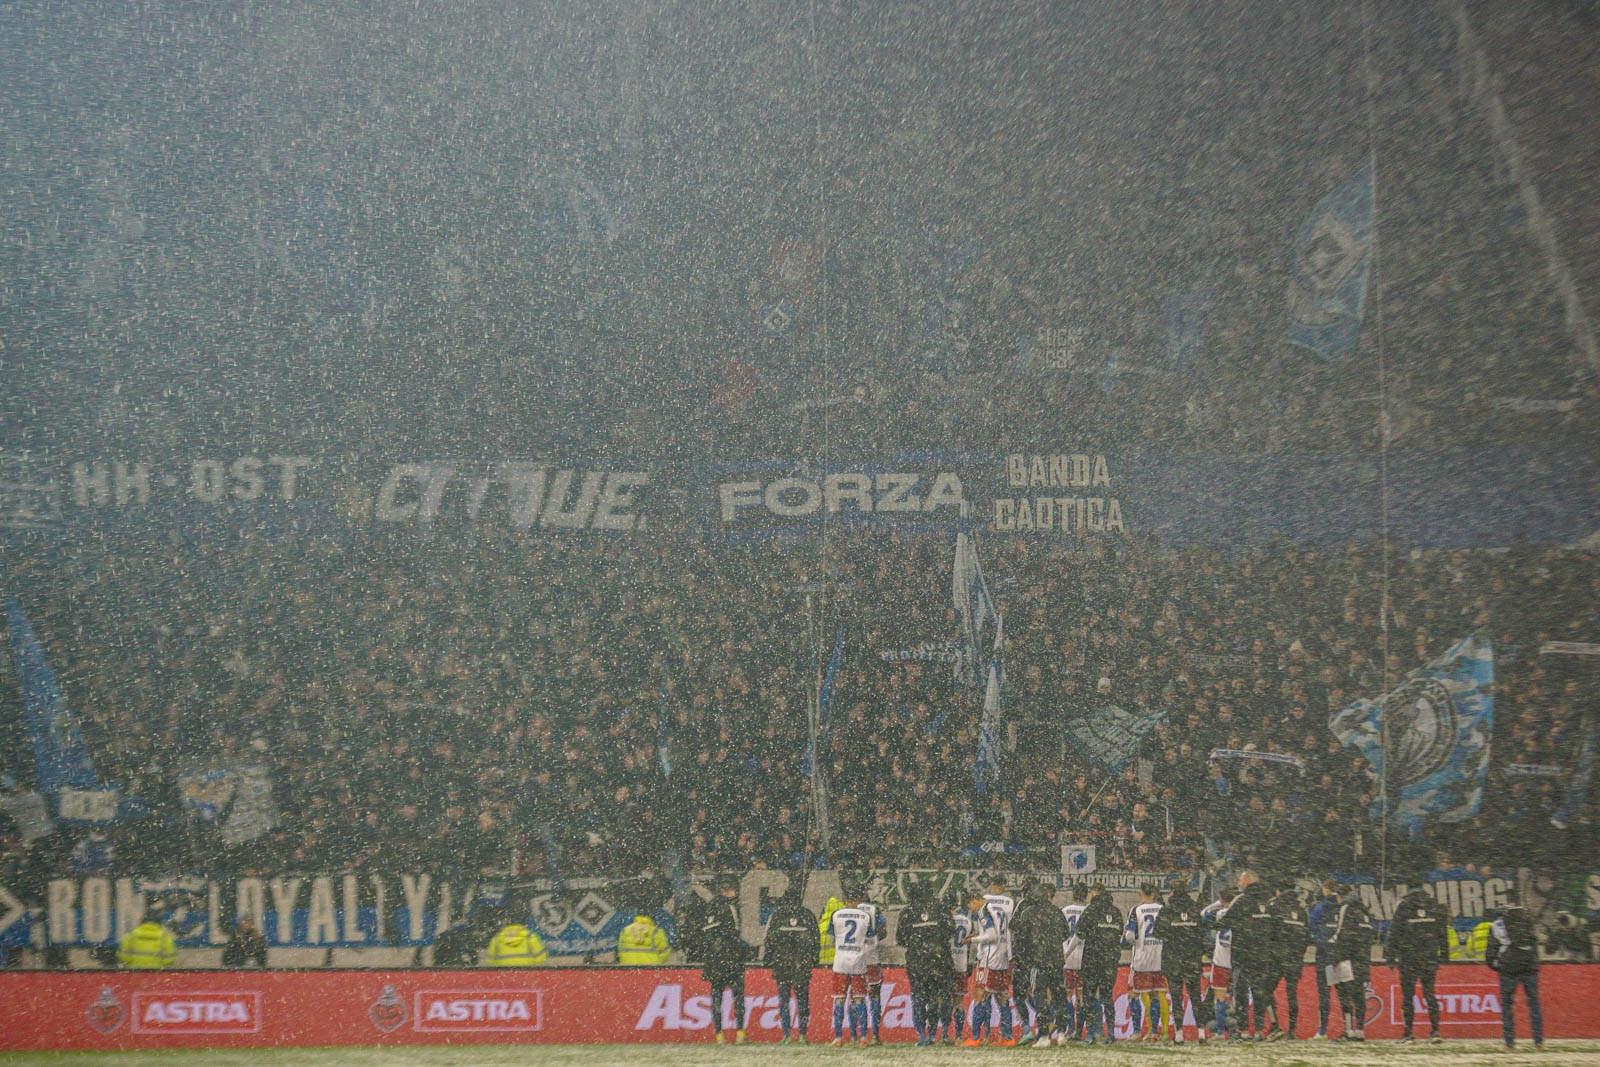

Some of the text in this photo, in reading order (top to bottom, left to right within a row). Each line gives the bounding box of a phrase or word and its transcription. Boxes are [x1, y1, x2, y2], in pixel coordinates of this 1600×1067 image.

[1008, 454, 1112, 489] BANDA
[718, 472, 969, 523] FORZA
[994, 497, 1125, 533] CAOTICA
[844, 919, 857, 944] 2
[144, 1001, 250, 1023] ASTRA
[425, 1000, 531, 1021] ASTRA
